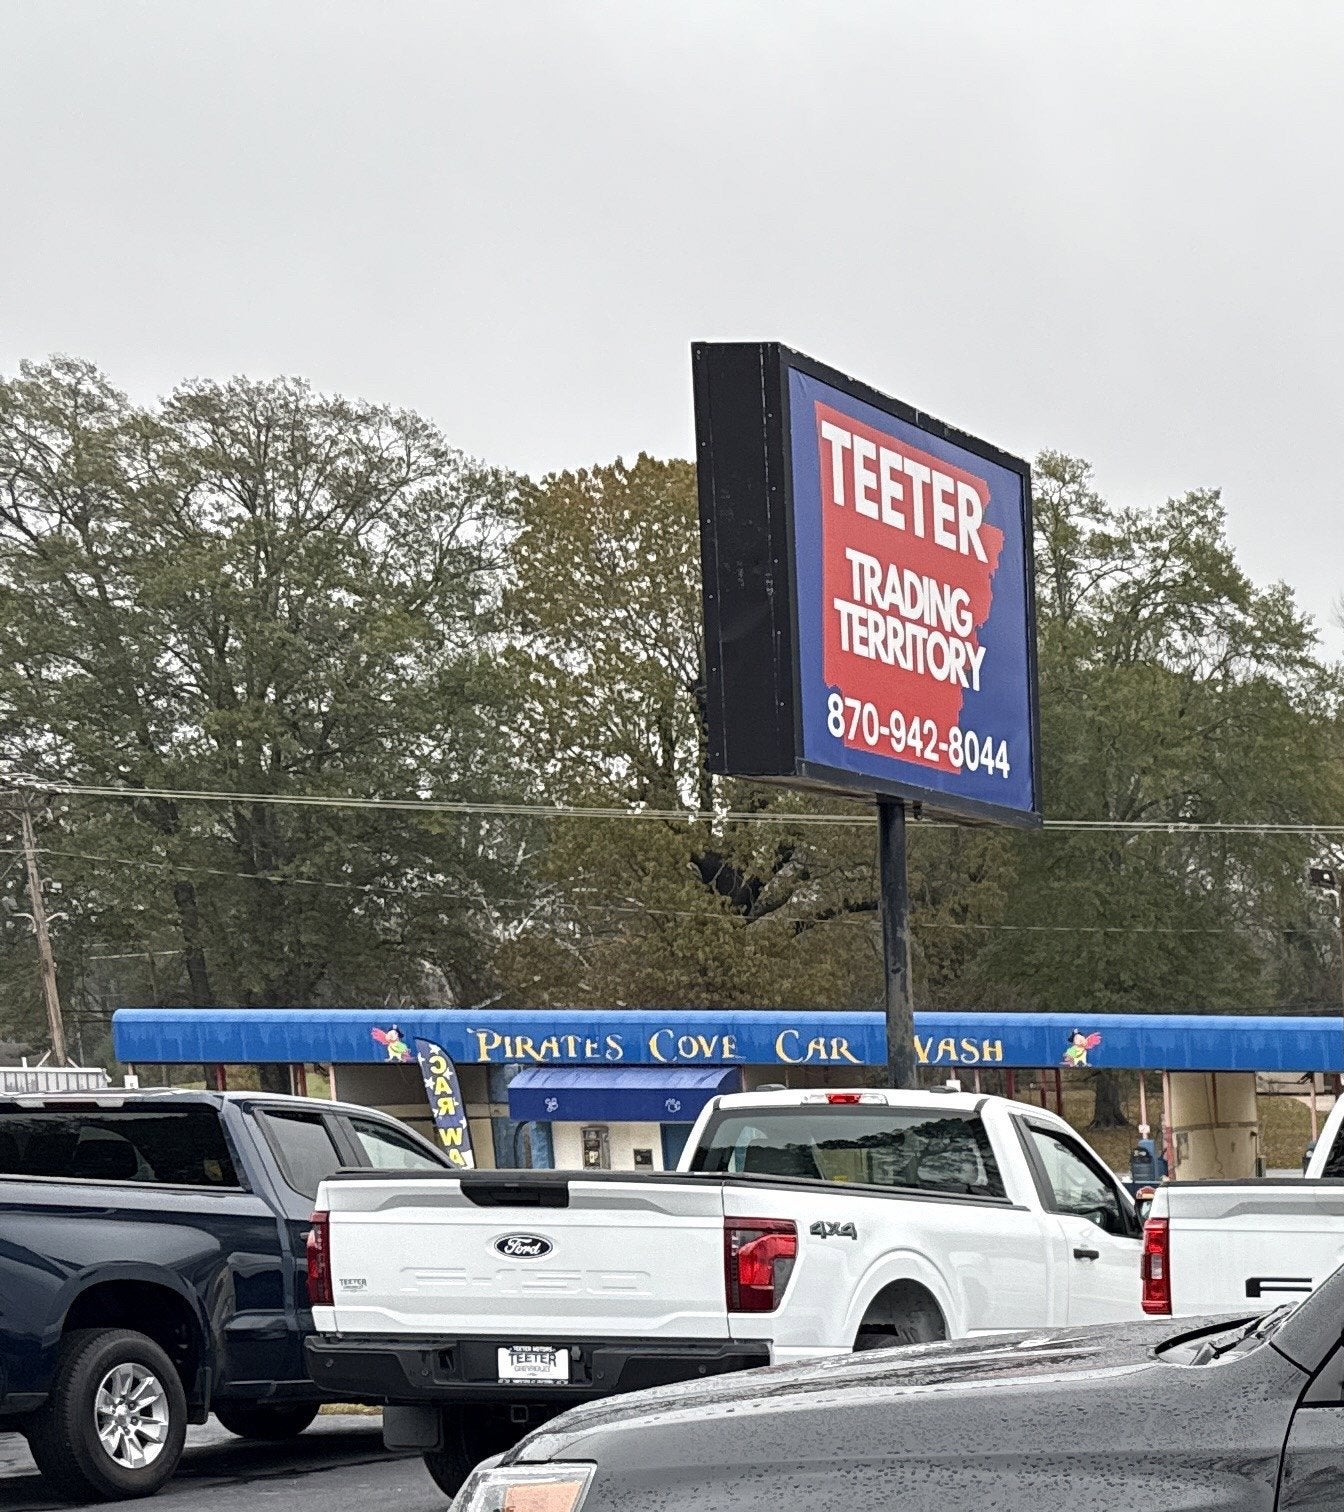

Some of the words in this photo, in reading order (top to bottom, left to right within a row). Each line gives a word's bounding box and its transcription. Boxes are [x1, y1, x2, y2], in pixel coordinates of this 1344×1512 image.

[820, 420, 989, 563] TEETER
[845, 547, 973, 635] TRADING
[834, 598, 987, 692] TERRITORY
[827, 692, 1011, 779] 870-942-8044
[467, 1028, 624, 1062] PIRATES
[649, 1028, 746, 1063] COVE
[775, 1029, 865, 1064] CAR
[503, 1237, 542, 1255] Ford
[400, 1266, 650, 1296] F-150
[508, 1352, 557, 1368] TEETER
